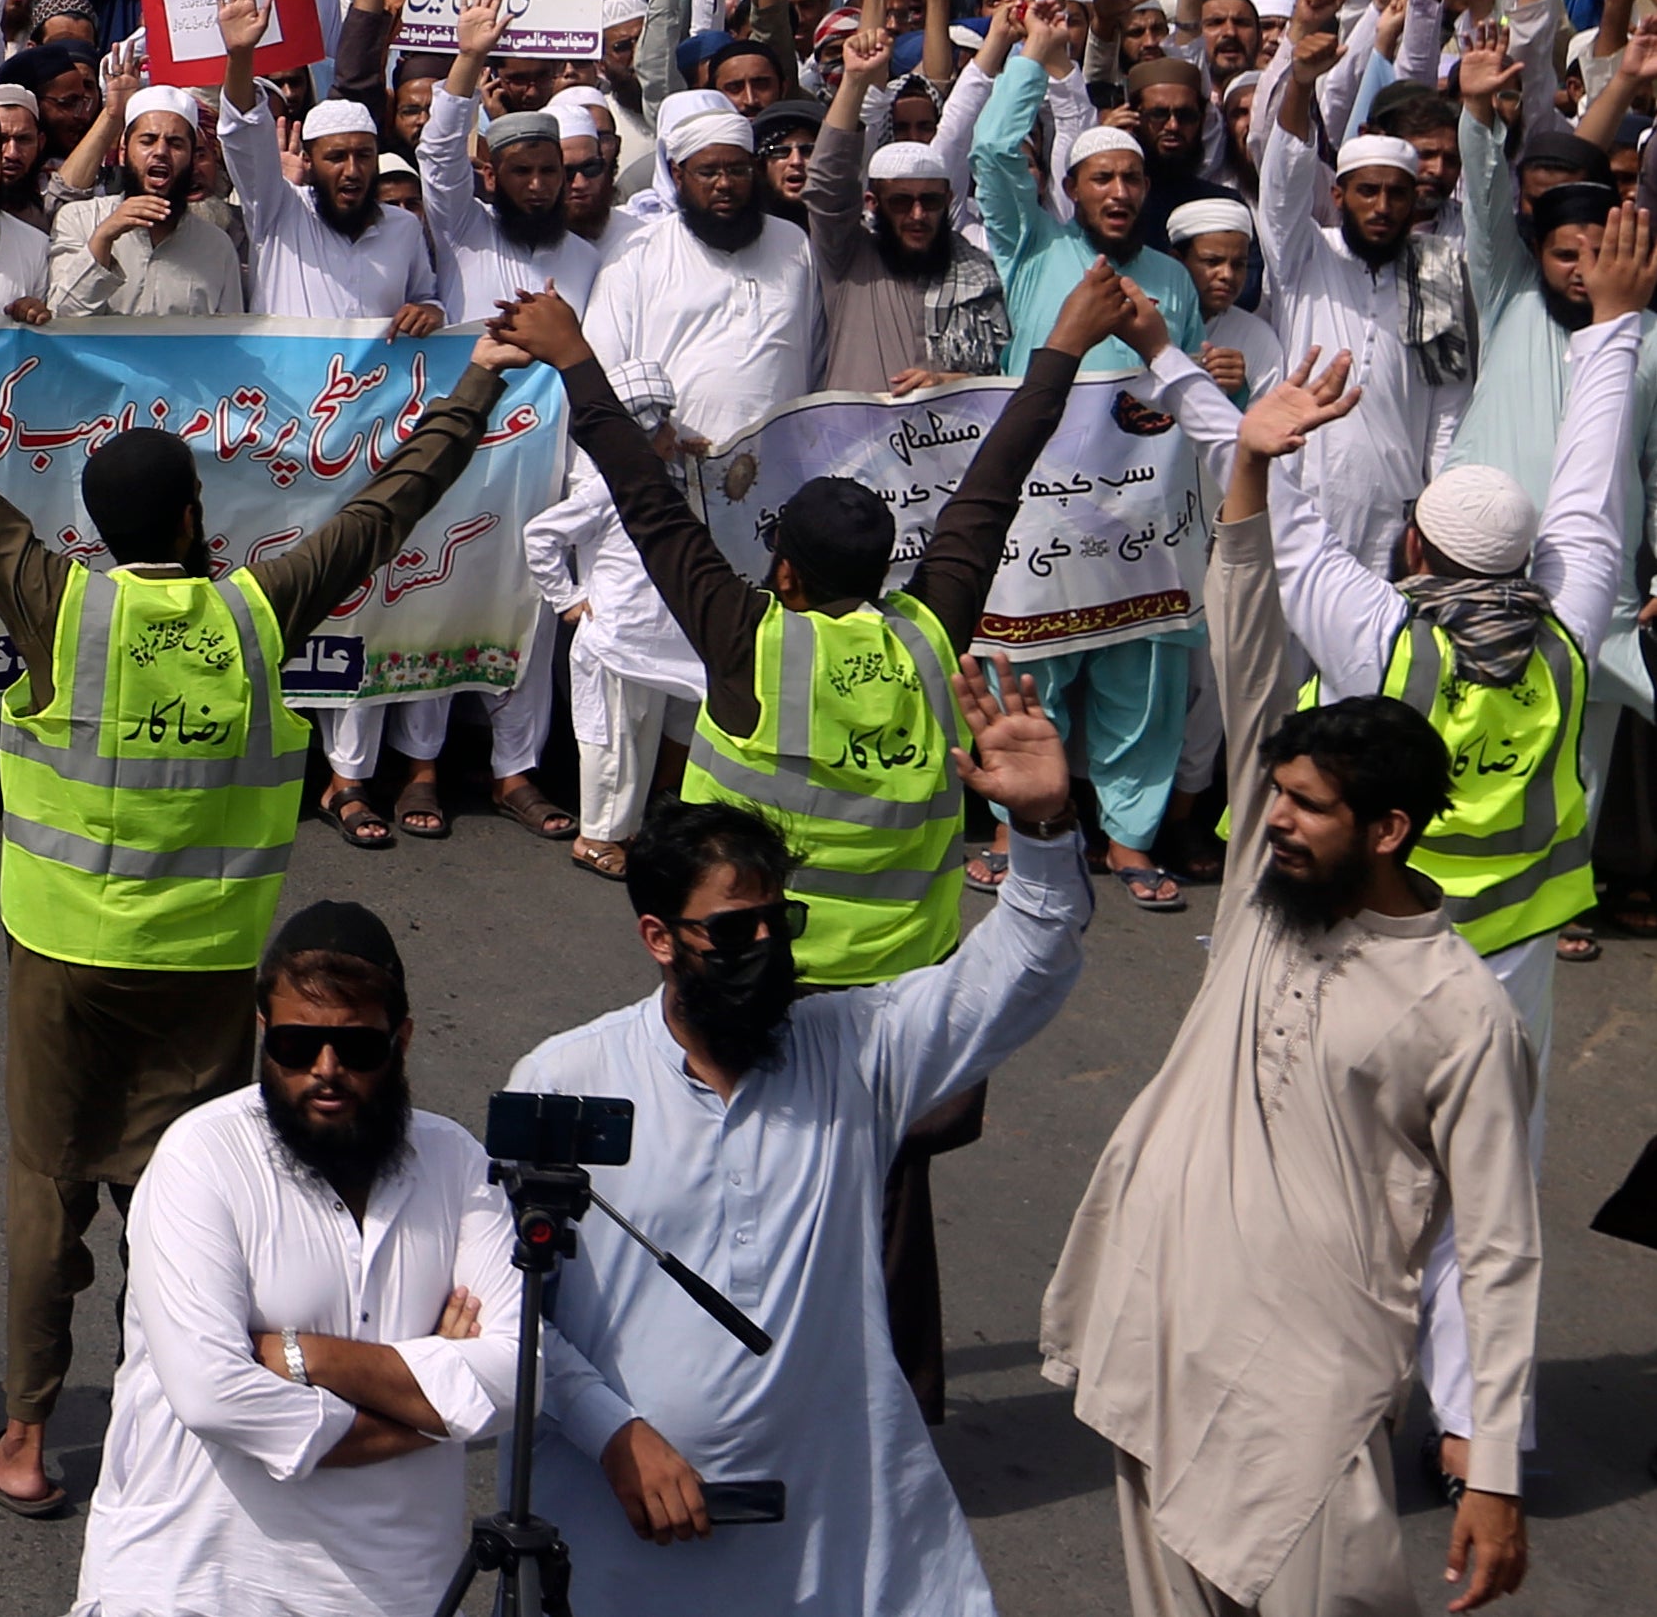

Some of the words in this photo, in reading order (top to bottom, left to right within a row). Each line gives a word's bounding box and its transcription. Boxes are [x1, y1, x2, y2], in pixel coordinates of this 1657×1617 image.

[179, 386, 268, 463] تمام
[307, 353, 388, 480] سطح
[889, 409, 981, 467] مسلمان
[253, 416, 300, 487] پر
[899, 483, 931, 509] کر
[1028, 472, 1093, 508] کچھ
[1097, 466, 1156, 496] سب
[1028, 537, 1072, 578] کی
[1118, 522, 1156, 562] نبی
[122, 693, 184, 744] کار
[177, 701, 234, 746] رضا
[828, 724, 885, 771] کار
[876, 726, 928, 770] رضا
[1451, 730, 1489, 778] کا
[1476, 734, 1536, 778] رضا
